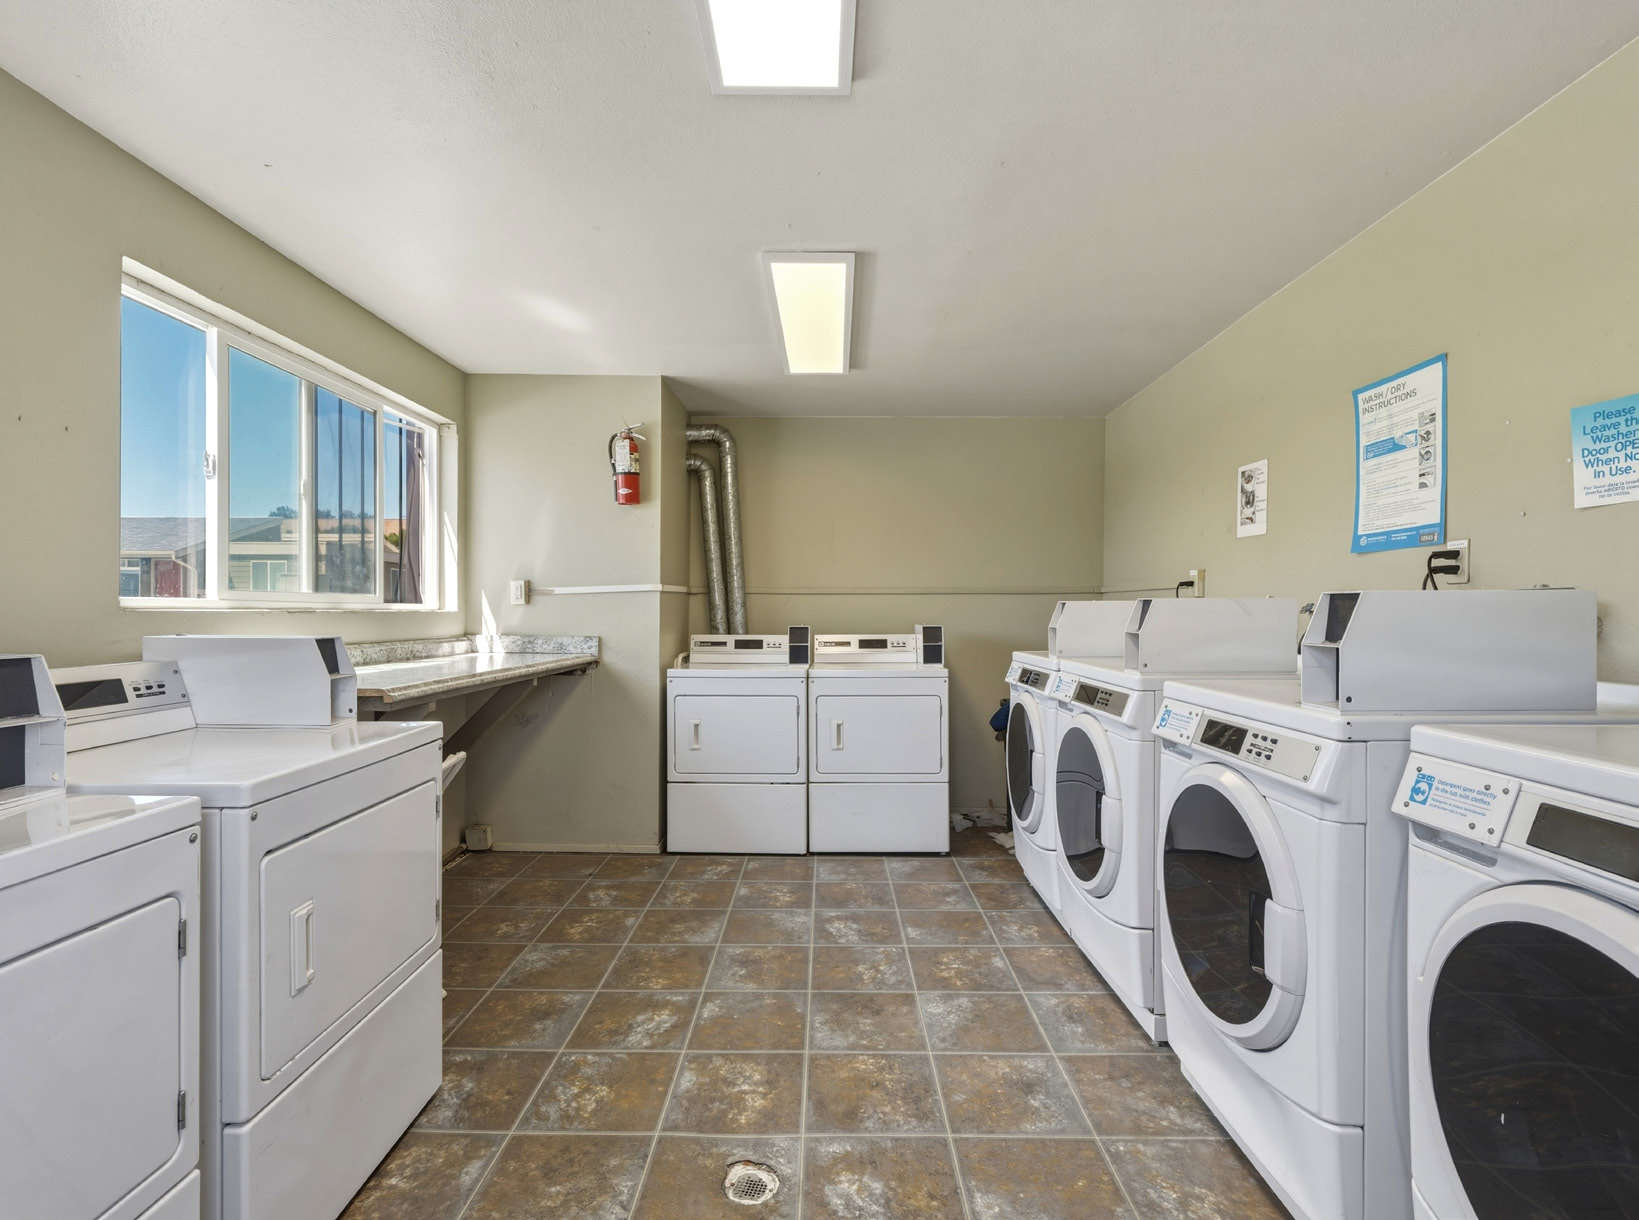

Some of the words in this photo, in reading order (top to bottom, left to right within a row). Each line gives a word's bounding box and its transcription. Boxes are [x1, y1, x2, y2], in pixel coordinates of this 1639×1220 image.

[1362, 391, 1384, 405] WASH
[1391, 381, 1407, 395] DRY
[1362, 388, 1417, 416] INSTRUCTIONS
[1593, 406, 1636, 422] Please
[1583, 421, 1621, 436] Leave
[1624, 416, 1639, 427] th
[1591, 429, 1639, 445] Washer
[1582, 445, 1612, 458] Door
[1615, 438, 1639, 452] OPE
[1583, 456, 1620, 469] When
[1625, 451, 1639, 462] NO
[1593, 468, 1605, 479] In
[1609, 465, 1636, 476] Use.
[1476, 790, 1497, 800] directly
